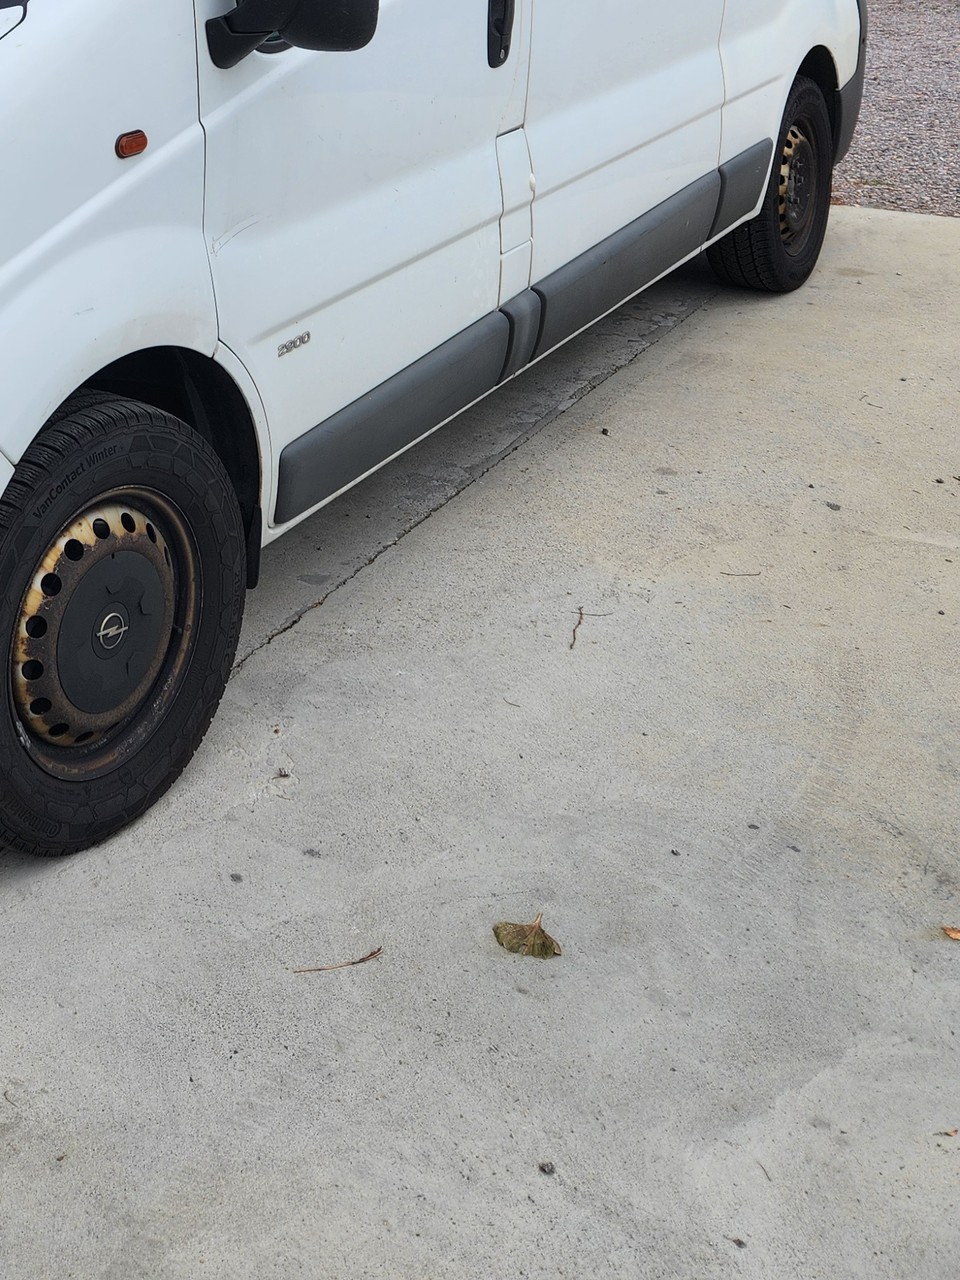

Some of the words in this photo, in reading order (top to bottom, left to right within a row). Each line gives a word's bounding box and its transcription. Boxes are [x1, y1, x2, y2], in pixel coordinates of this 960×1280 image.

[277, 330, 311, 358] 2900
[33, 464, 85, 519] VanContact
[85, 443, 118, 468] Winter
